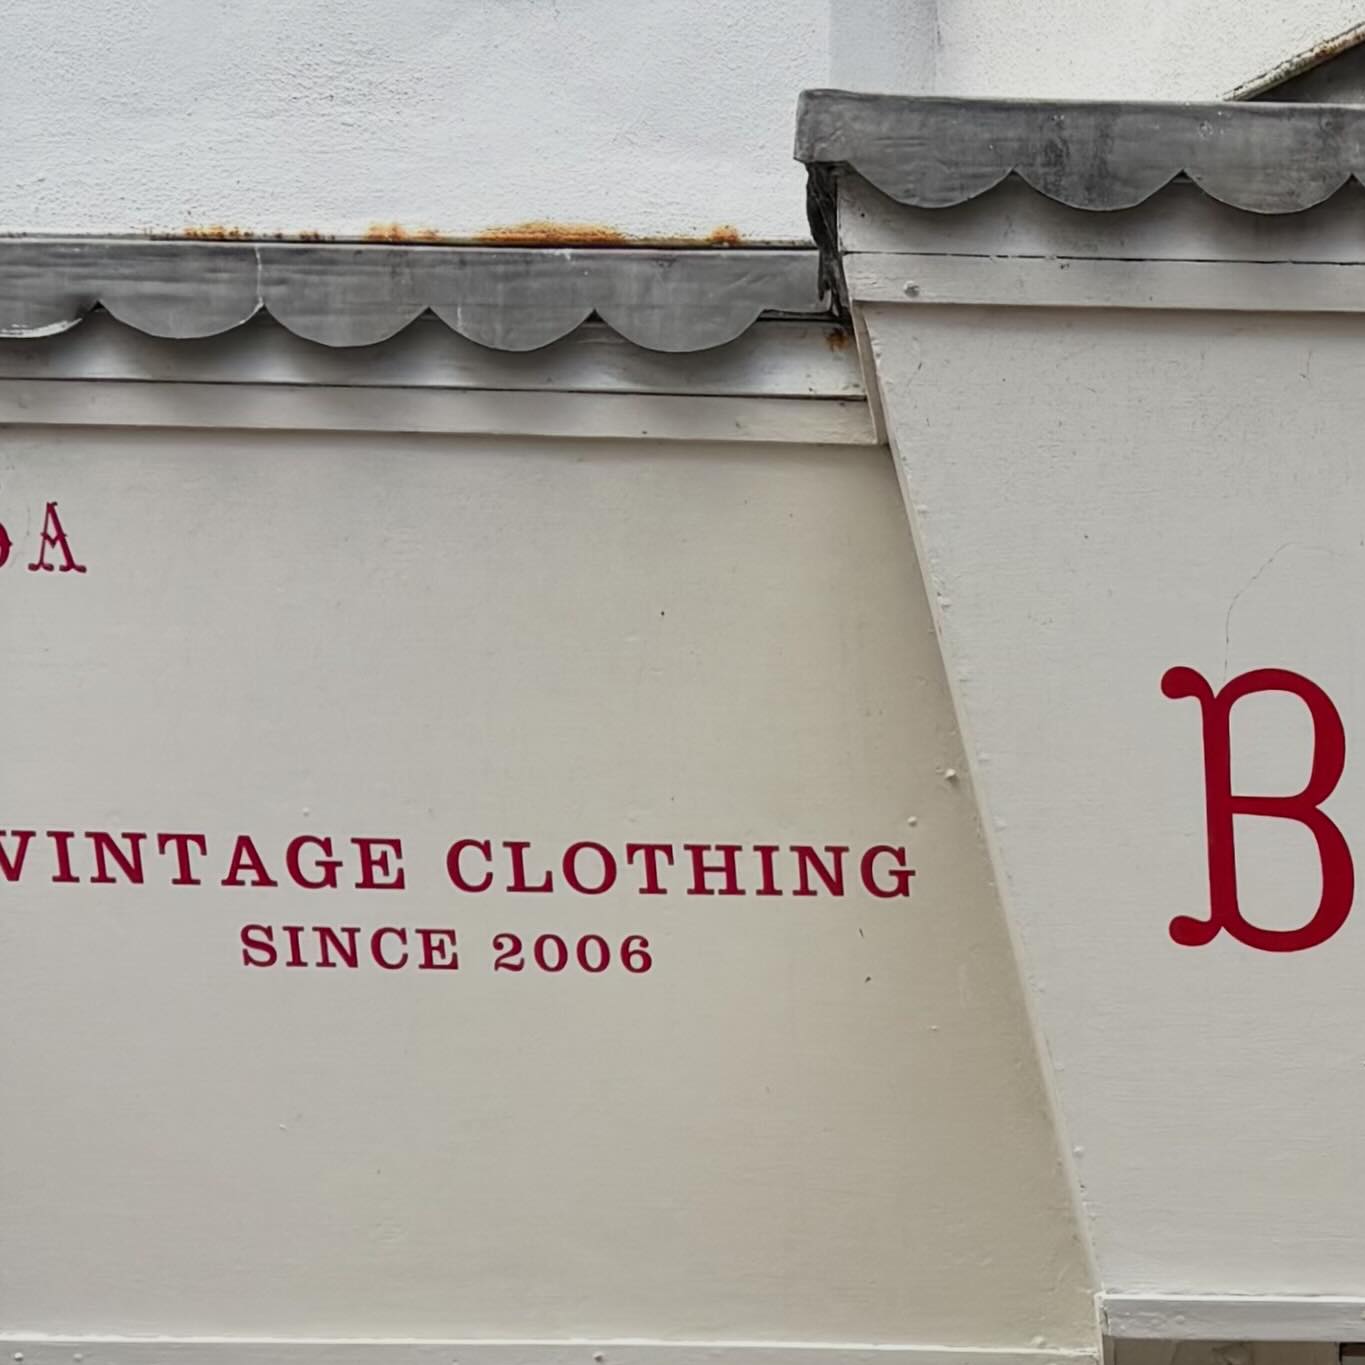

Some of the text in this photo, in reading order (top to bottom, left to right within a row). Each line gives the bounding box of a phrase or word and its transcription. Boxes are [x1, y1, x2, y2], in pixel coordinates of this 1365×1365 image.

[0, 829, 916, 899] VINTAGE CLOTHING
[241, 925, 653, 974] SINCE 2006
